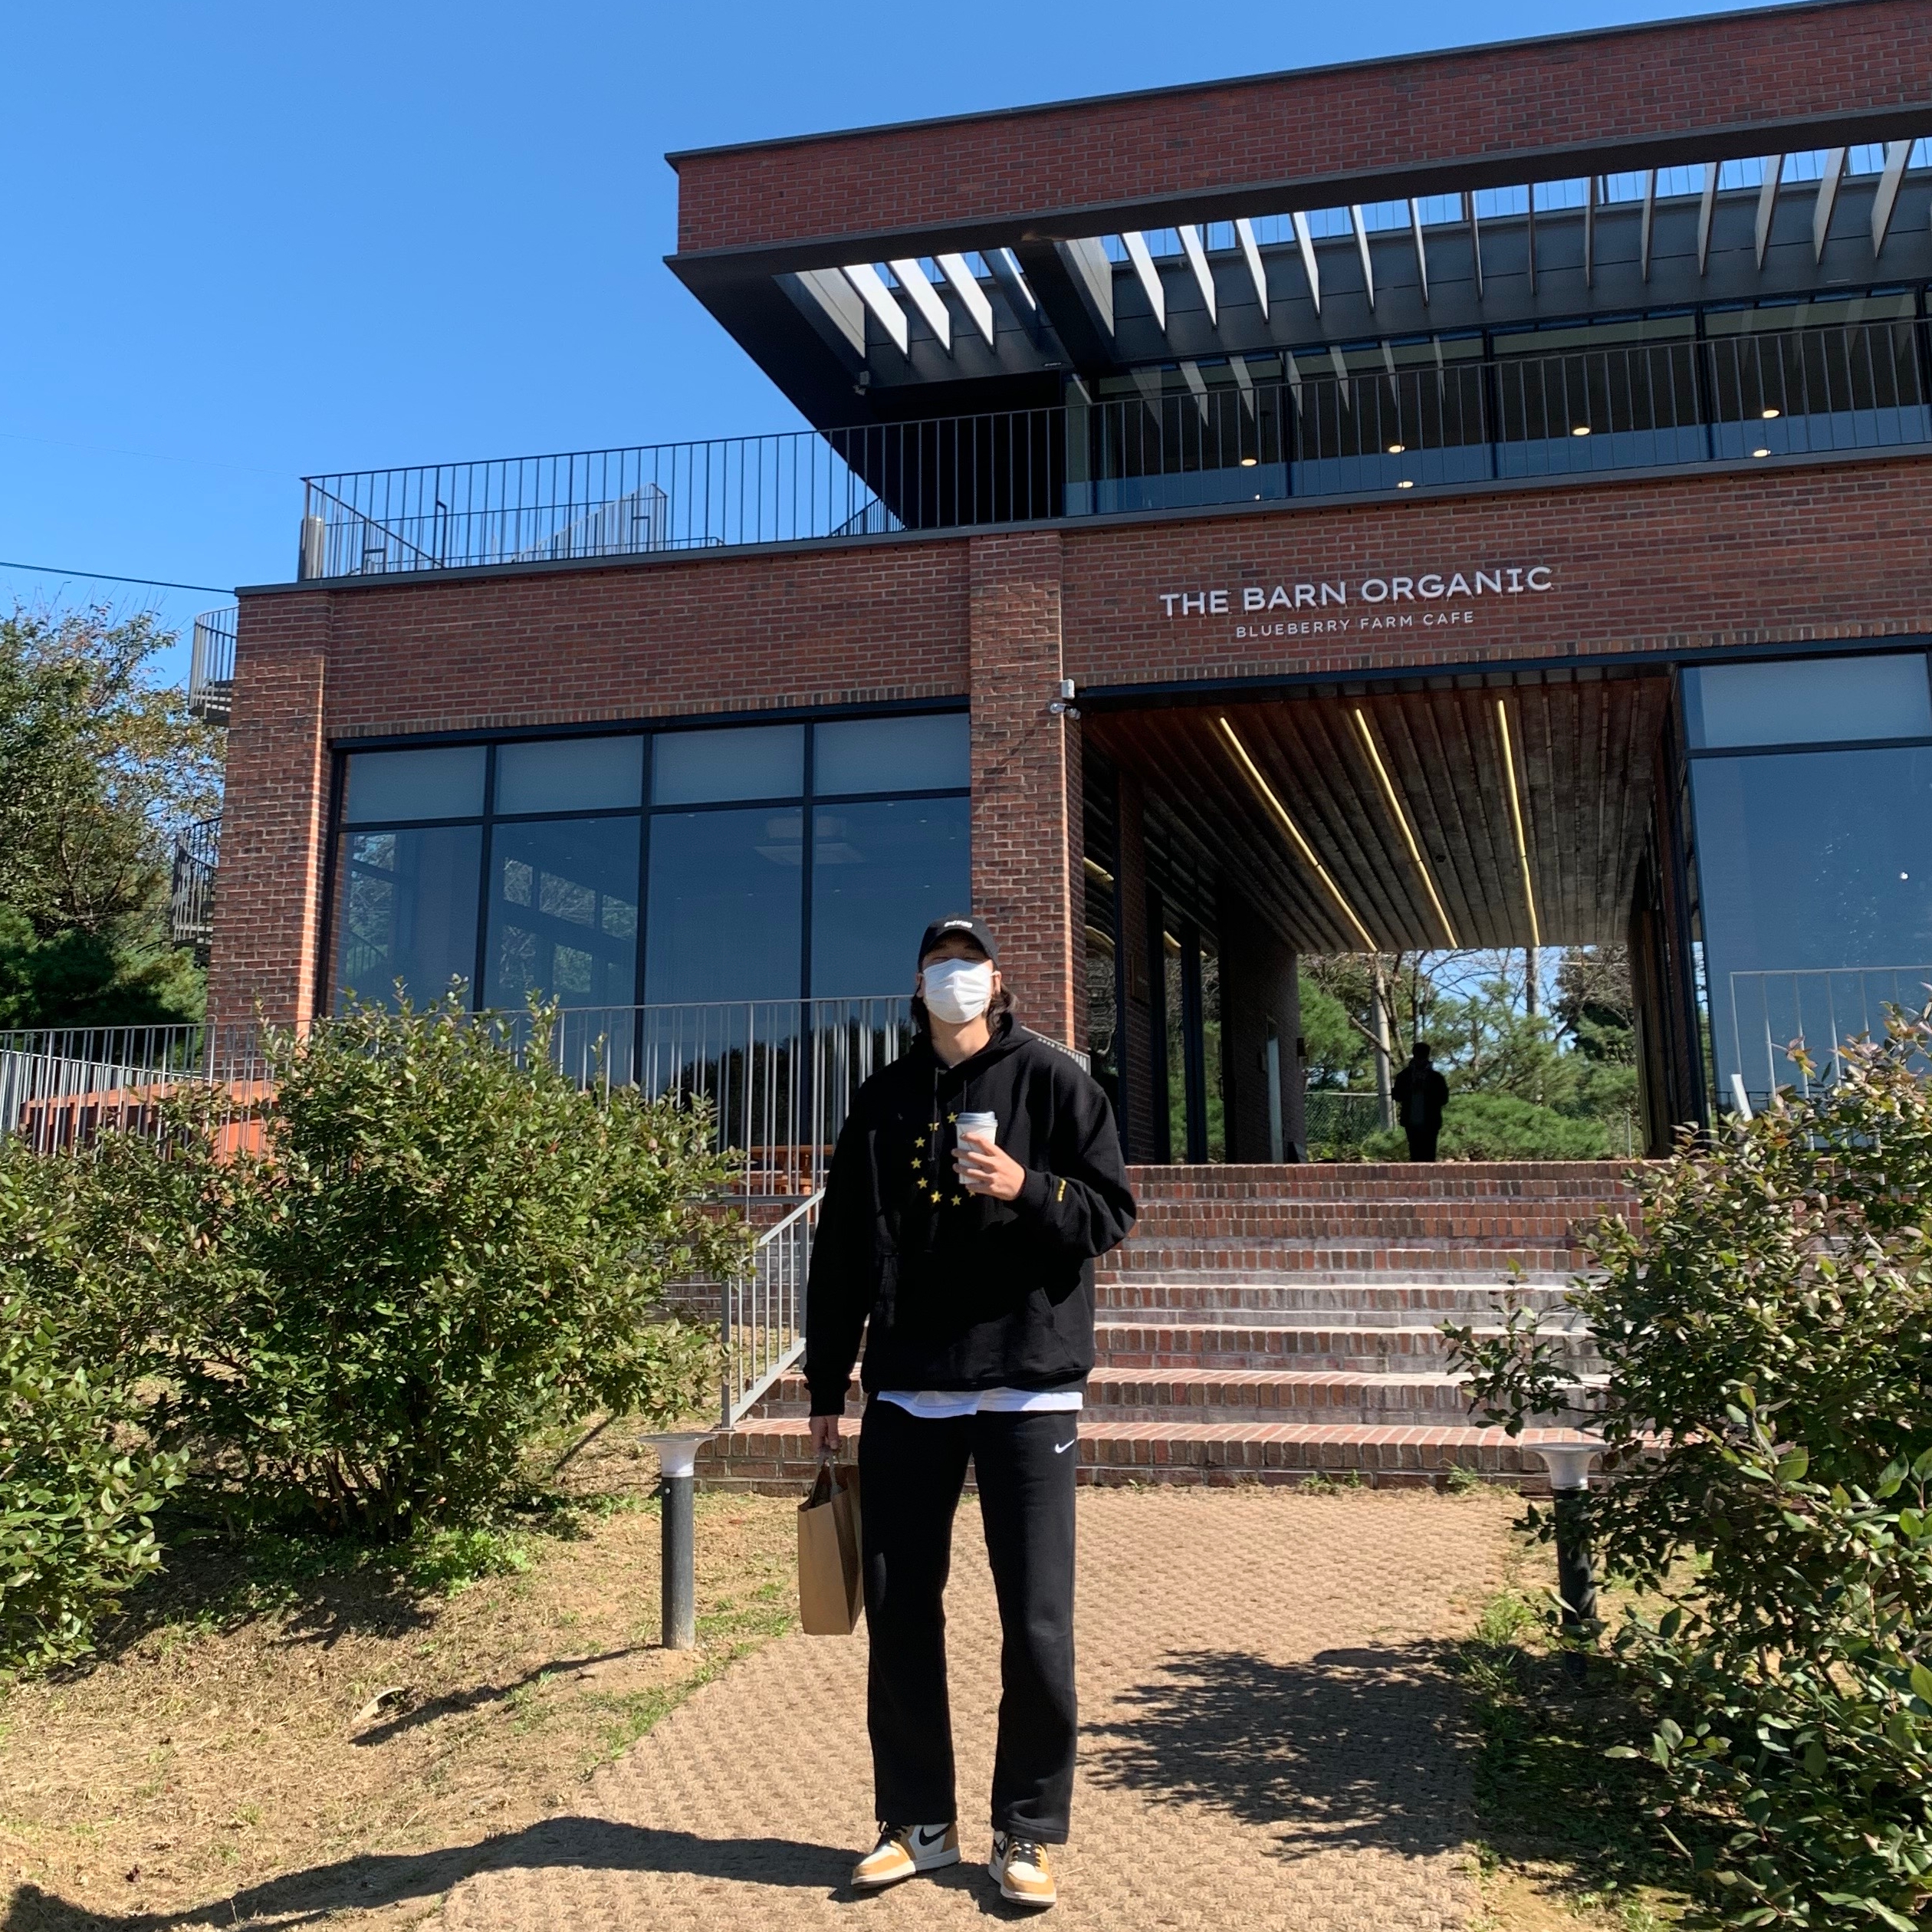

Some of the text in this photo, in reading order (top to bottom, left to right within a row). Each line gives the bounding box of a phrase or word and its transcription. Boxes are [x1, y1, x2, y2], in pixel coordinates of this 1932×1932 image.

[1158, 565, 1553, 616] THE BARN ORGANIC
[1236, 610, 1474, 639] BLUEBERRY FARM CAFE
